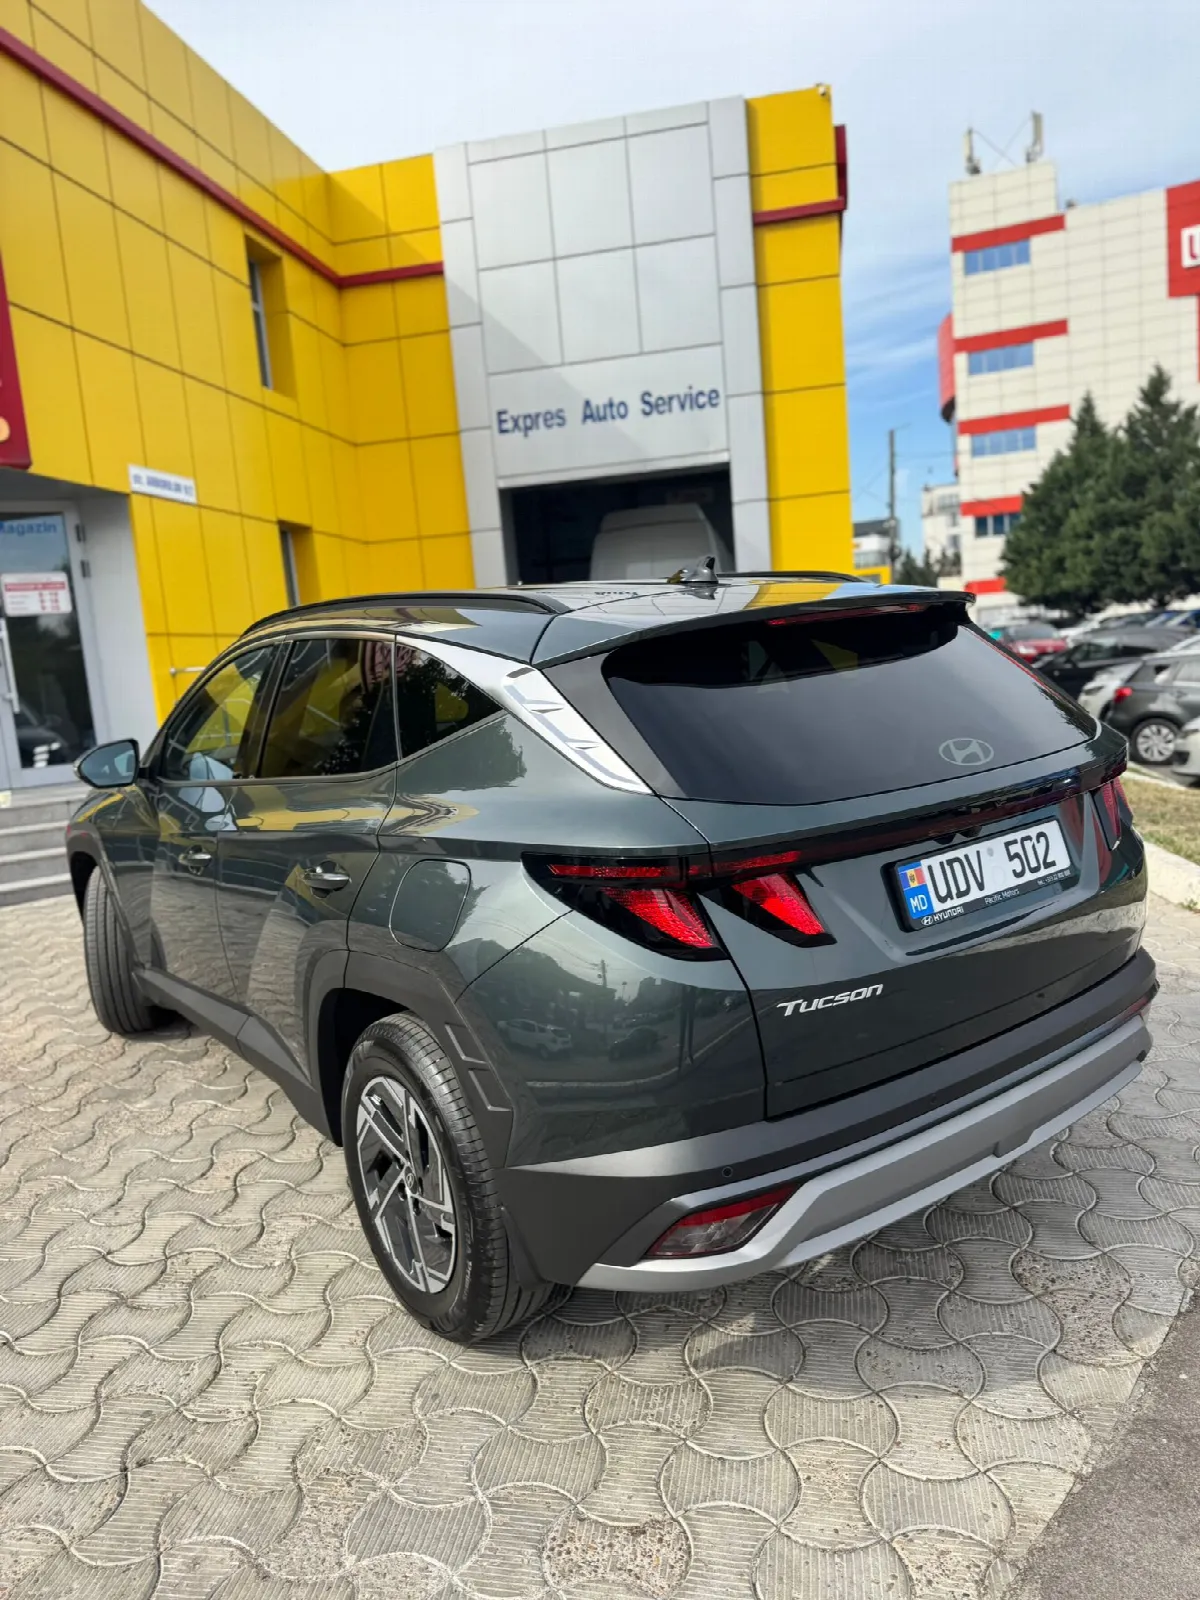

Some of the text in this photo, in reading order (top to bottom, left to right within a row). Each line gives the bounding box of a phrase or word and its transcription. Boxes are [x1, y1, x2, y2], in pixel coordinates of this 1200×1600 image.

[496, 384, 721, 438] Expres Auto Service
[927, 831, 1057, 904] UDV 502
[910, 894, 928, 913] MD
[933, 906, 965, 922] HYUNDAI
